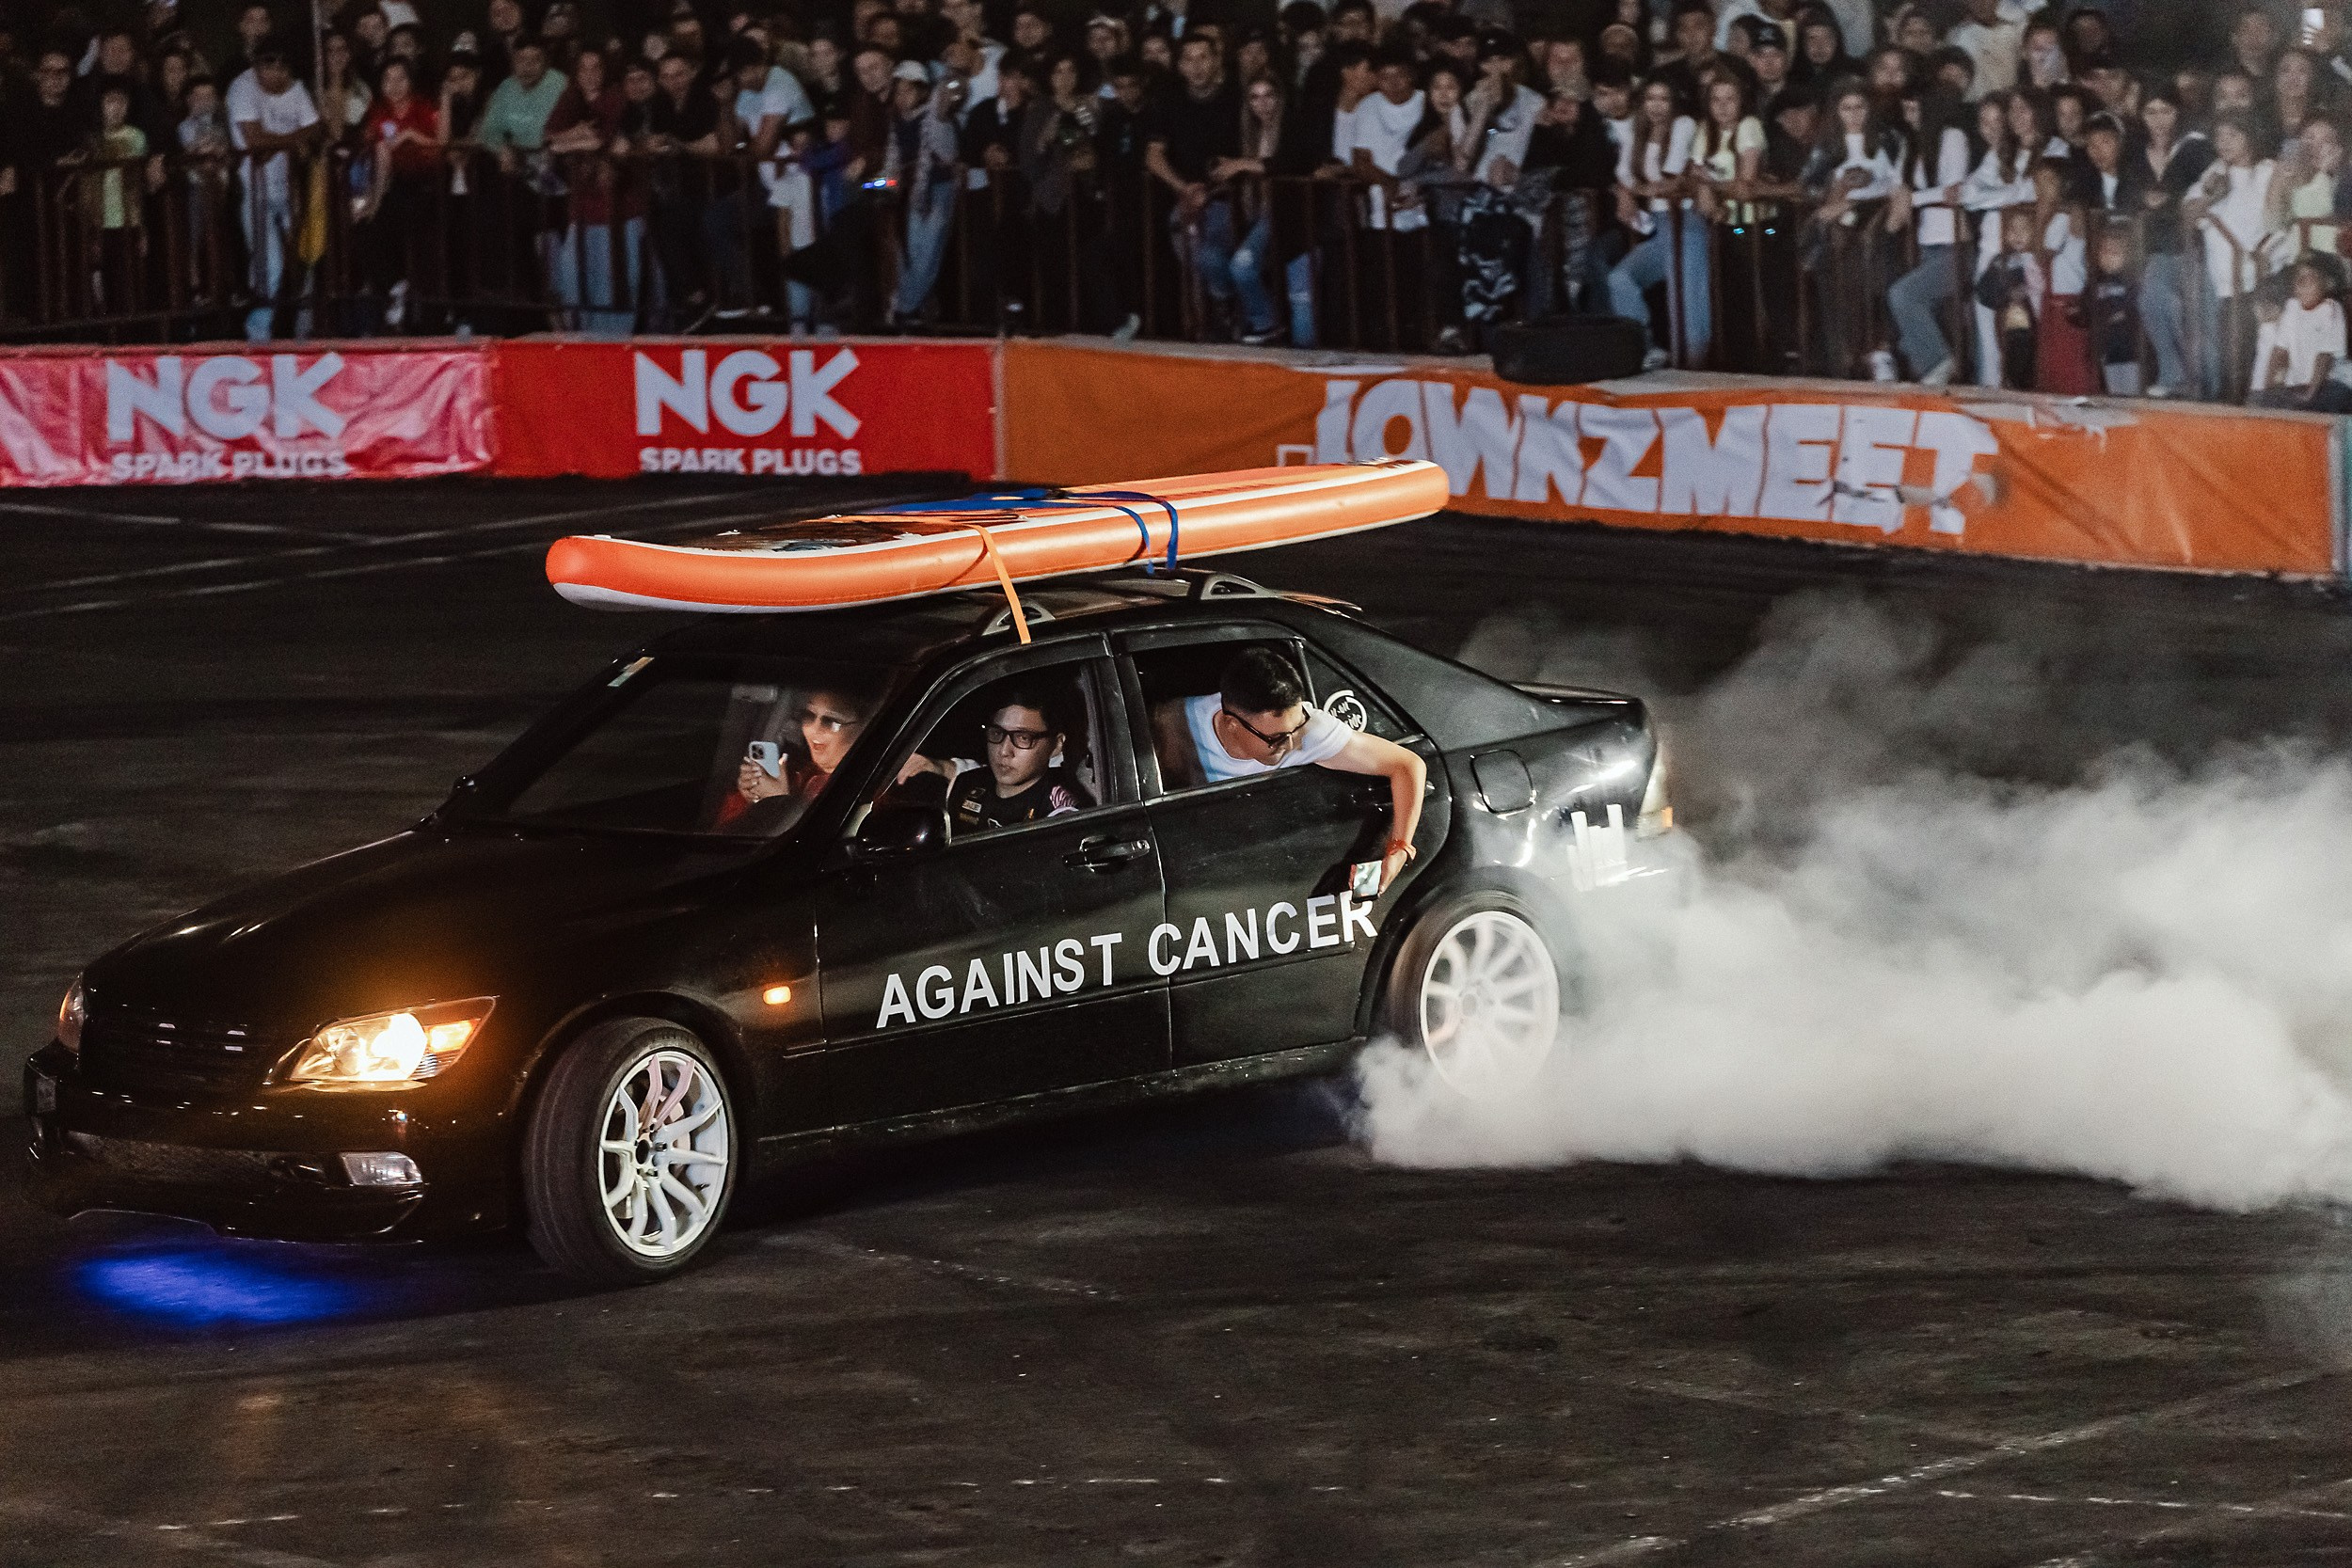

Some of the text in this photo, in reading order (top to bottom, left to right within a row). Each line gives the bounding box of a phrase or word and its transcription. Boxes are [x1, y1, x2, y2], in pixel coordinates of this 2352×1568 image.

[106, 352, 344, 442] NGK
[634, 348, 862, 440] NGK
[111, 450, 351, 482] SPARK PLUGS
[639, 446, 863, 476] SPARK PLUGS
[876, 890, 1378, 1029] AGAINST CANCER
